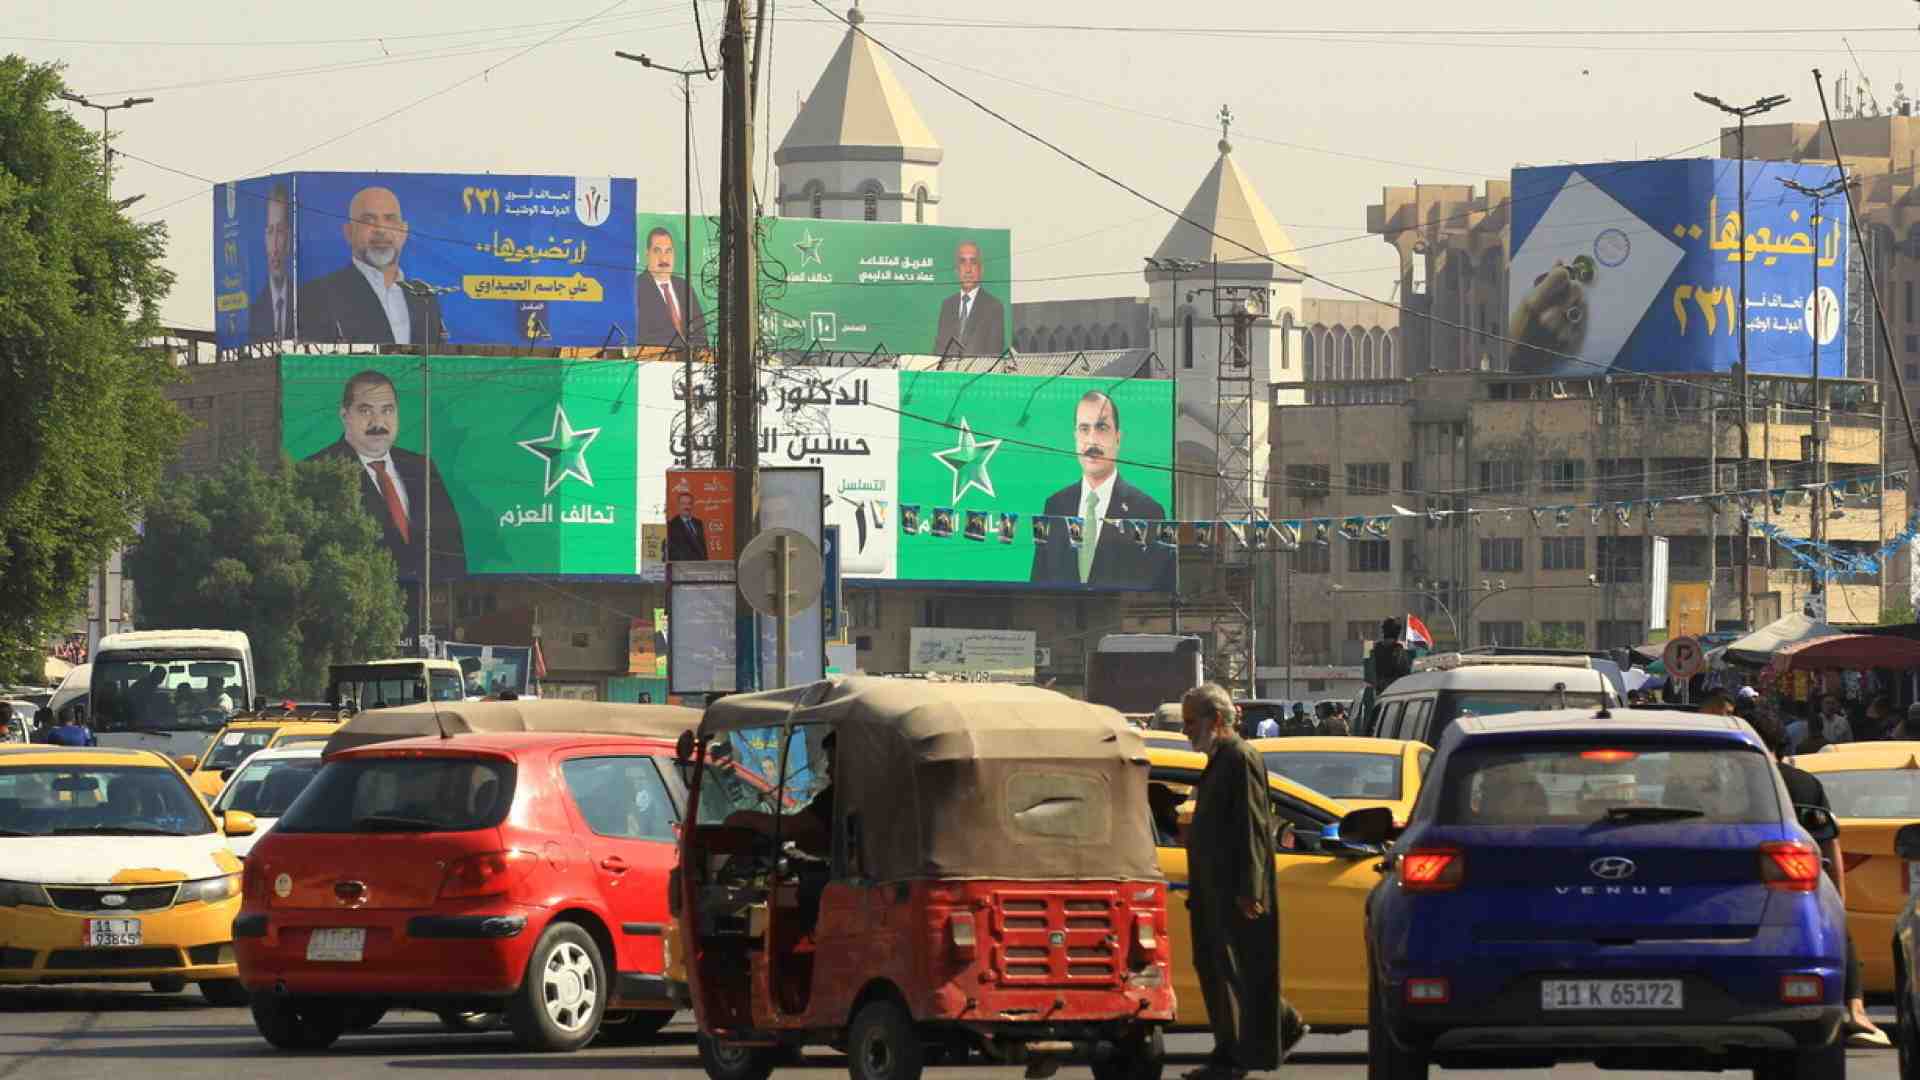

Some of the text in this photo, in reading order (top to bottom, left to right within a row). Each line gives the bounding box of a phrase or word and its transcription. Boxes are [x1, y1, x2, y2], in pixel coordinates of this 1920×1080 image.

[534, 280, 566, 295] جاسم
[569, 279, 589, 297] علي
[1673, 285, 1737, 337] ٢٣١
[776, 378, 869, 412] الدكتور
[787, 437, 871, 465] حسين
[499, 502, 615, 528] تحالف العزم
[1554, 885, 1673, 895] VENUE
[1556, 983, 1675, 1006] 11 K 65172
